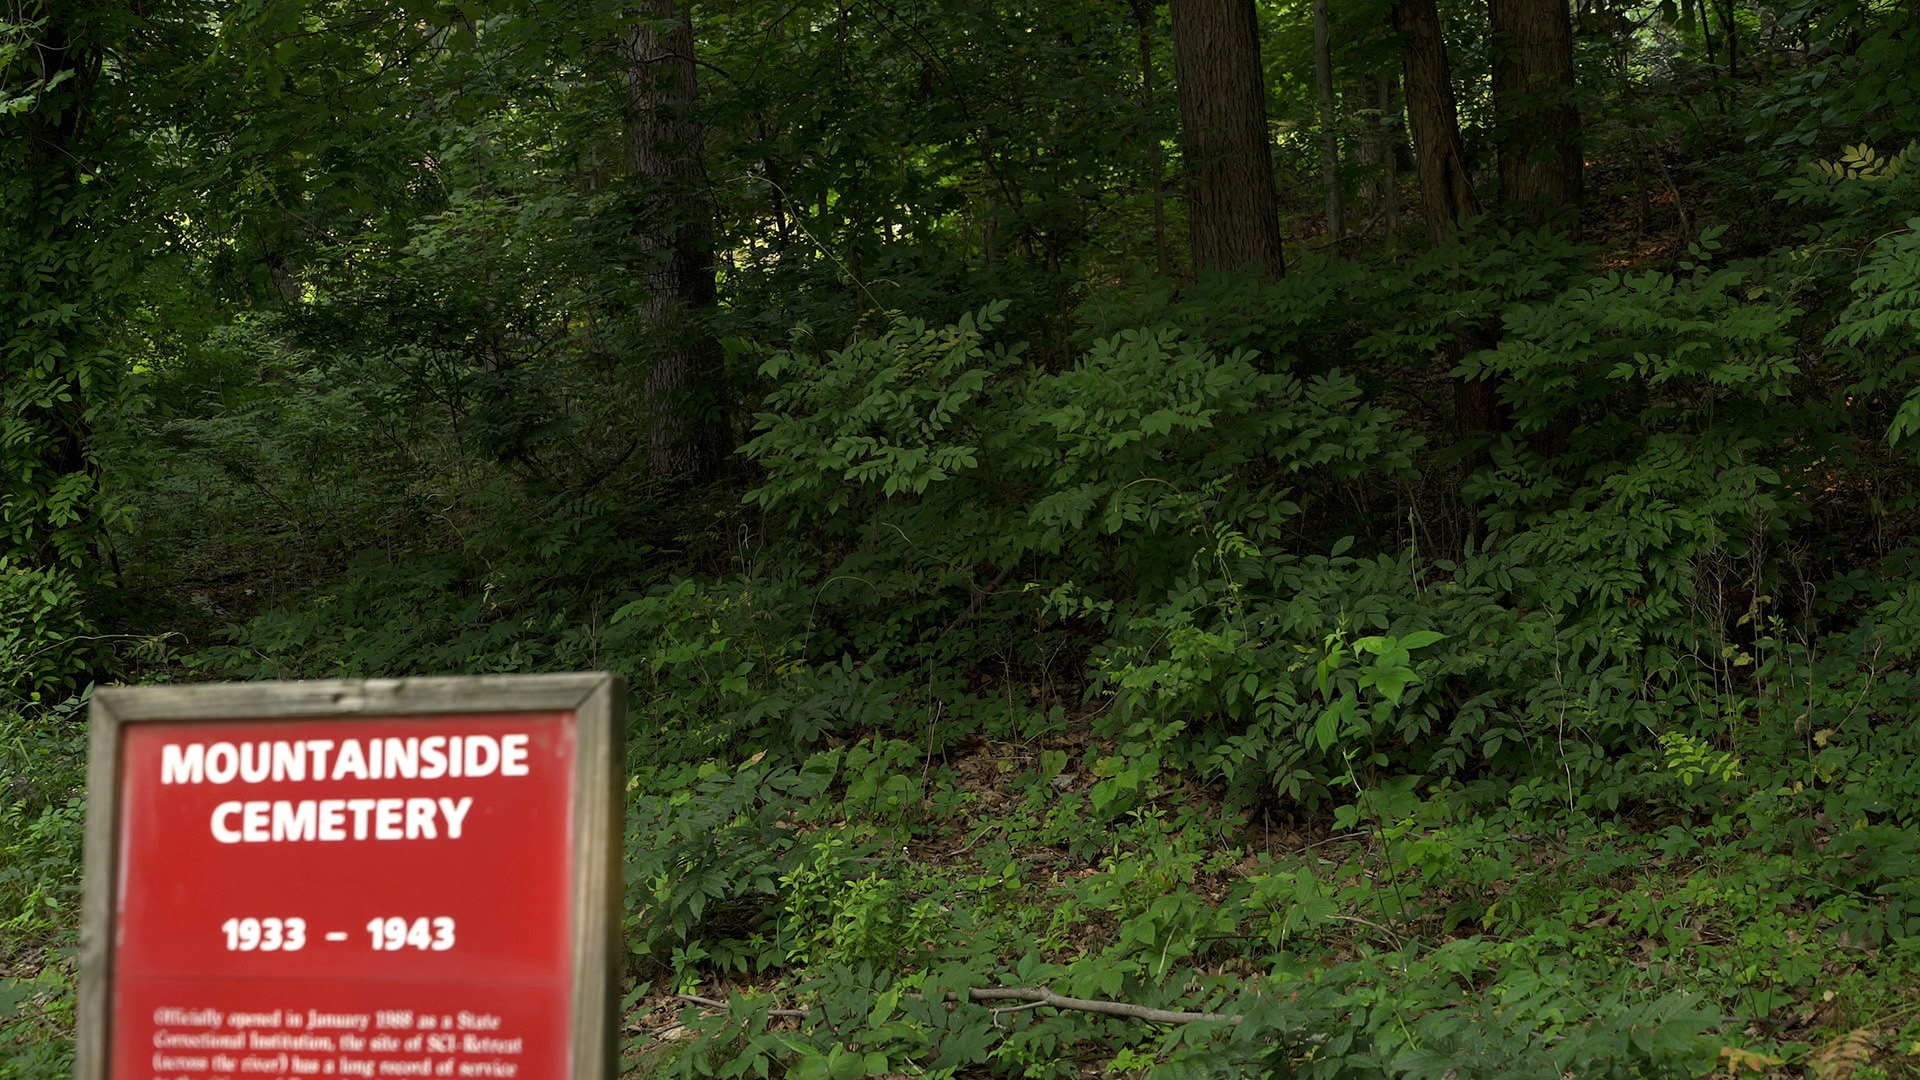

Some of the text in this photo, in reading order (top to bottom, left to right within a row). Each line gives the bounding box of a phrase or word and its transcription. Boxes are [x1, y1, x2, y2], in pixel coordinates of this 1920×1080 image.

[161, 734, 529, 784] MOUNTAINSIDE
[211, 797, 472, 843] CEMETERY
[222, 917, 306, 951] 1933
[367, 917, 455, 951] 1943
[154, 1008, 223, 1029] Officially
[227, 1009, 282, 1029] opened
[285, 1009, 303, 1028] in
[306, 1009, 370, 1031] January
[417, 1015, 437, 1029] as
[441, 1015, 453, 1029] a
[457, 1011, 501, 1030] State
[153, 1030, 246, 1049] Correctional
[339, 1034, 366, 1051] the
[404, 1034, 422, 1052] of
[212, 1054, 237, 1072] the
[241, 1053, 288, 1073] river)
[291, 1055, 320, 1074] has
[323, 1060, 335, 1074] a
[339, 1056, 375, 1077] long
[379, 1058, 432, 1075] record
[434, 1058, 454, 1076] of
[459, 1058, 519, 1076] service
